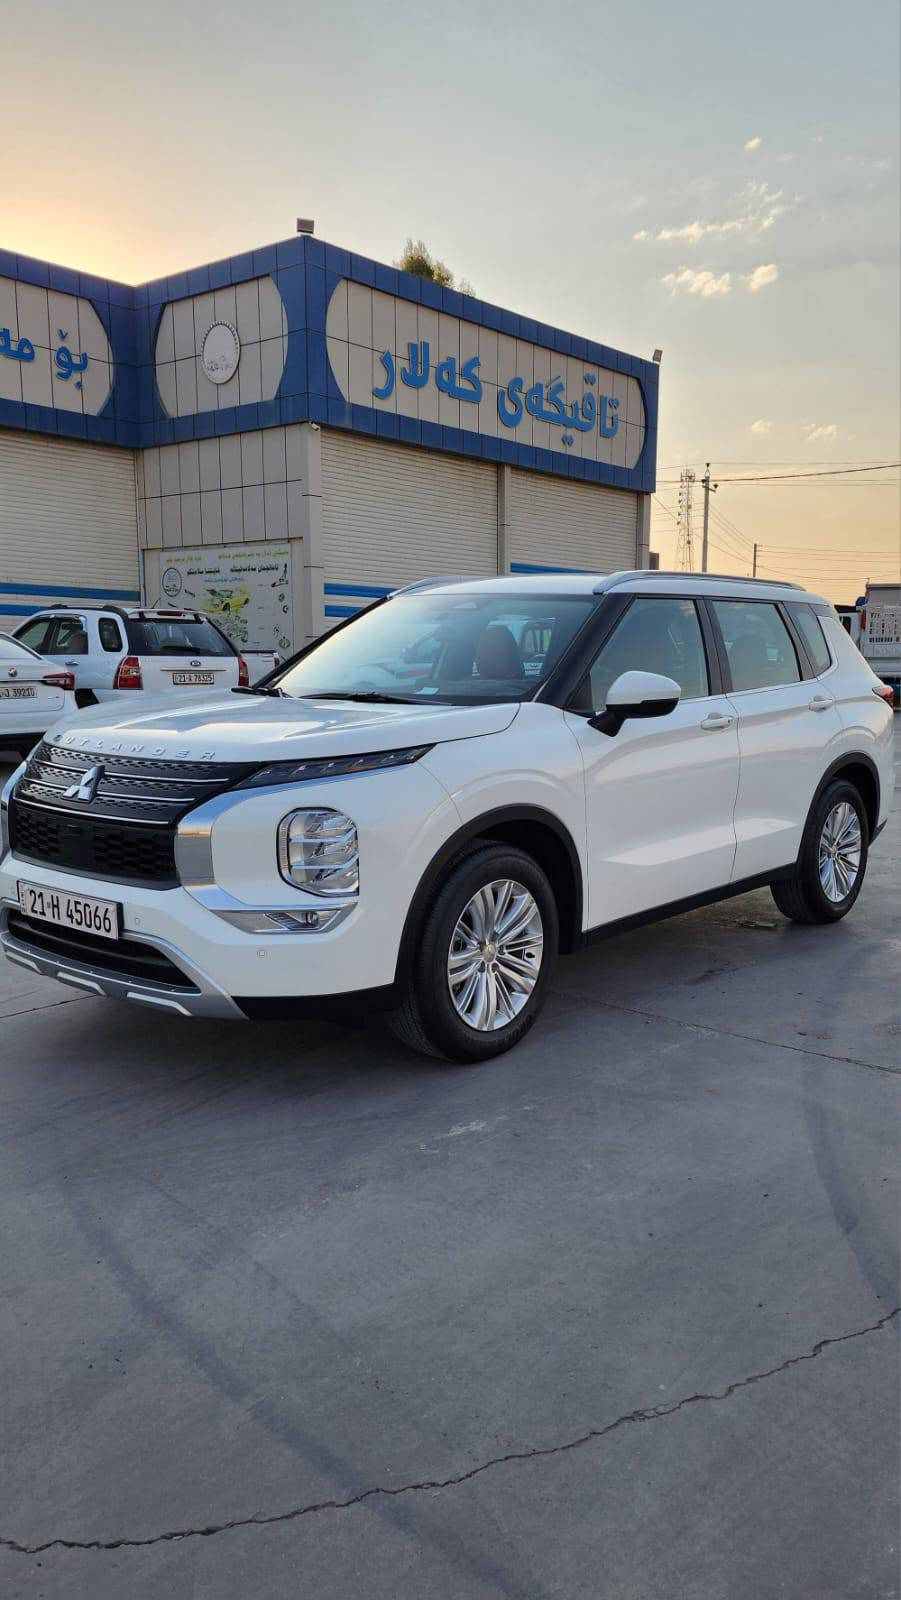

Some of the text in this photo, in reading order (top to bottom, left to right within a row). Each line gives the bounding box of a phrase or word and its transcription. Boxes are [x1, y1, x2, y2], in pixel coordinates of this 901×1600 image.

[54, 329, 89, 391] بۆ
[372, 340, 482, 404] کەلار
[53, 734, 215, 760] OUTLANDER
[66, 898, 112, 934] 45066
